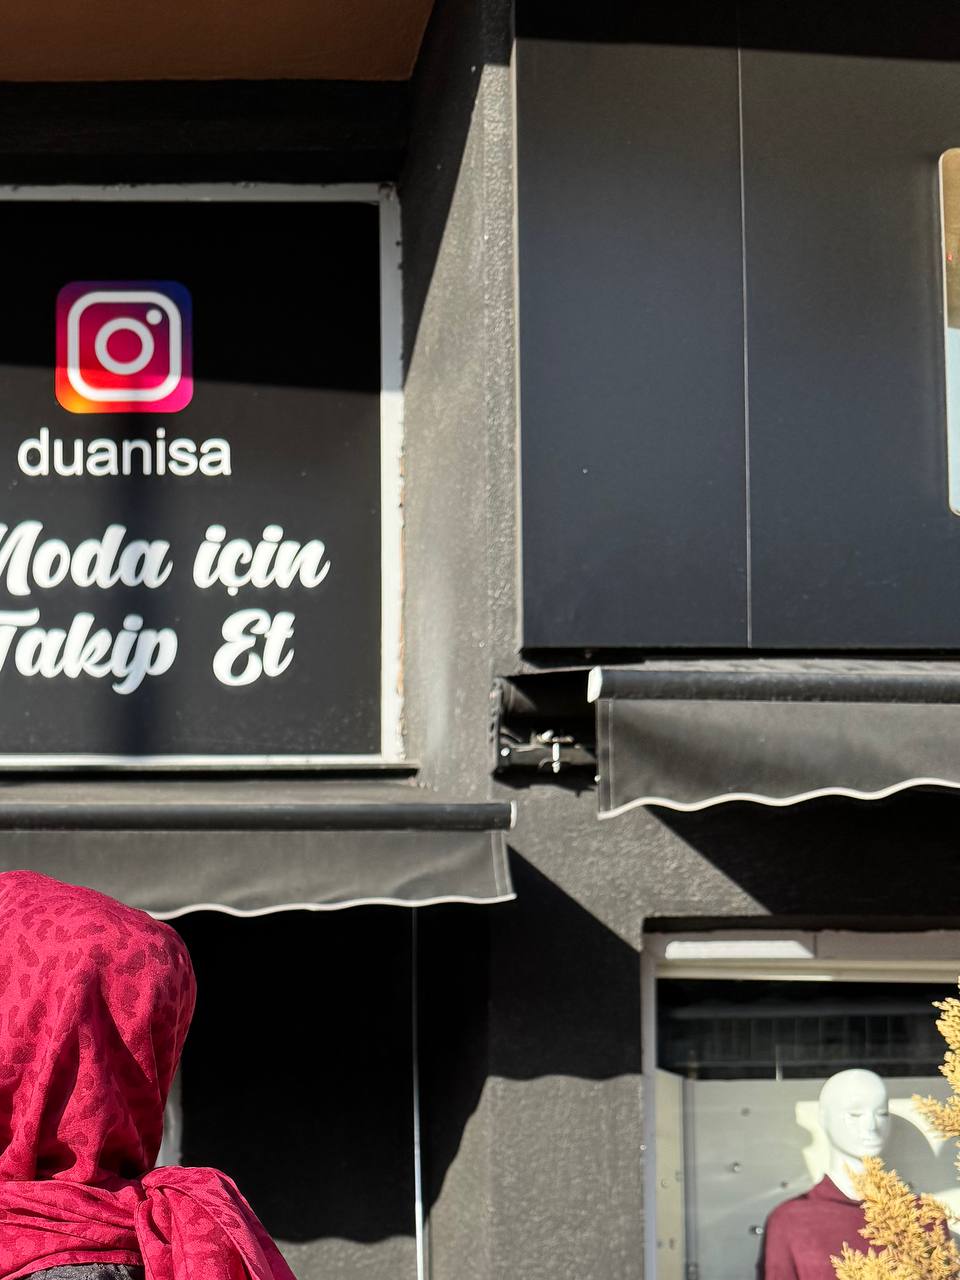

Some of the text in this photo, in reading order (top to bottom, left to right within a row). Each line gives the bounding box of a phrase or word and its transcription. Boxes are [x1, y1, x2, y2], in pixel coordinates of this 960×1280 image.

[17, 427, 232, 477] duanisa
[192, 524, 331, 597] için
[212, 608, 296, 687] Et
